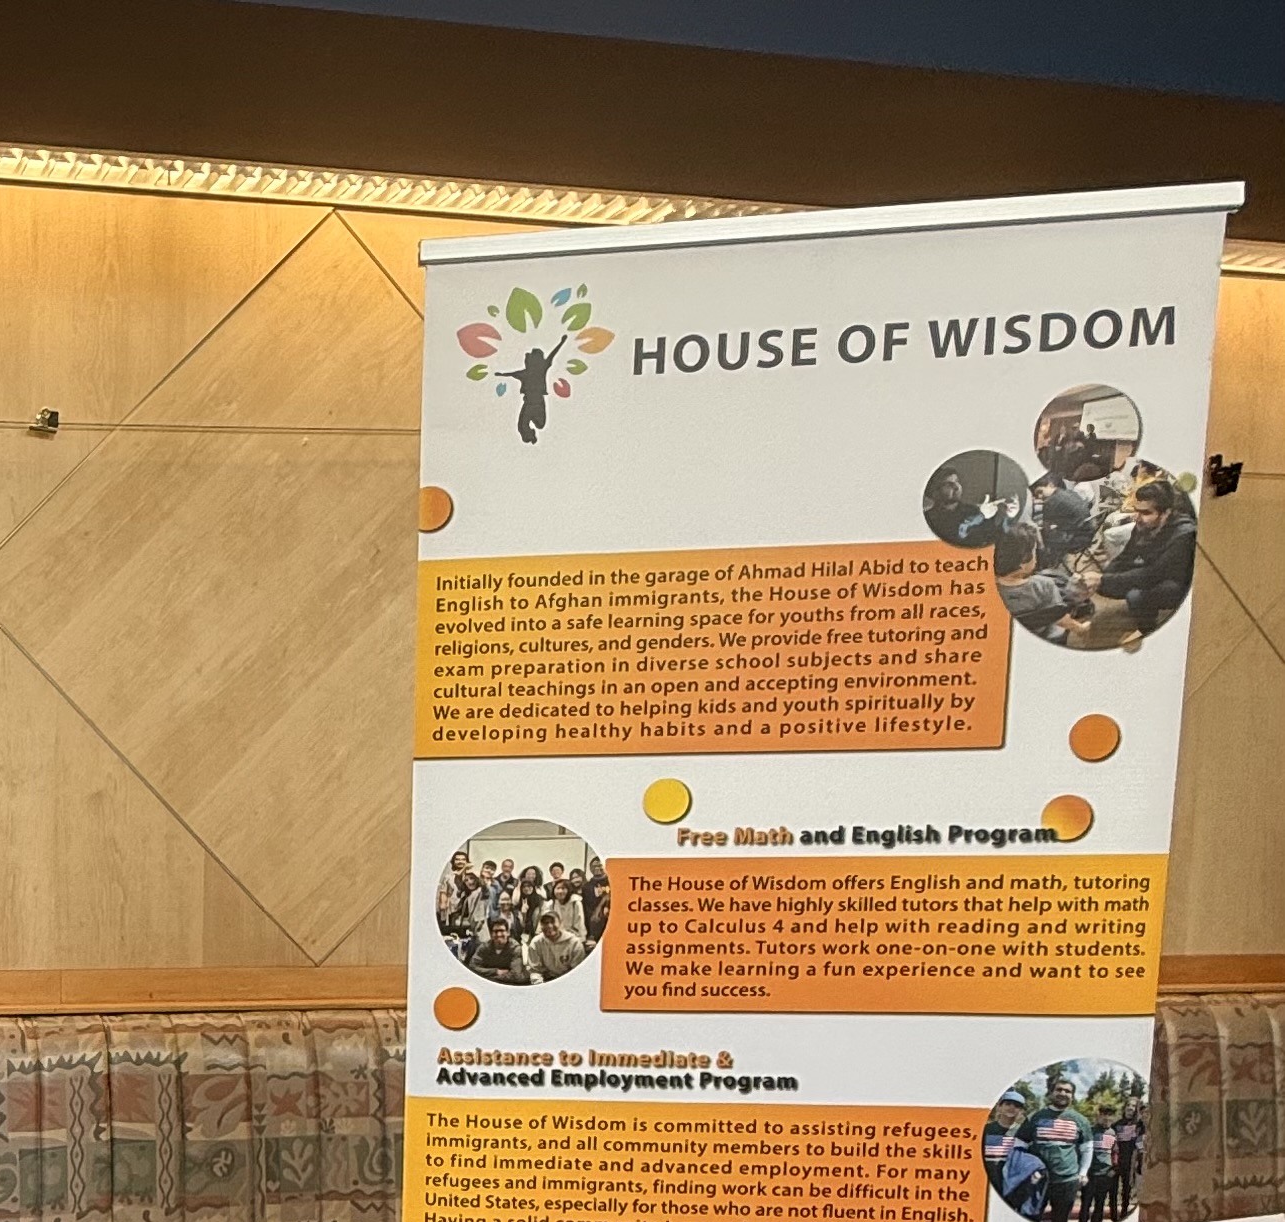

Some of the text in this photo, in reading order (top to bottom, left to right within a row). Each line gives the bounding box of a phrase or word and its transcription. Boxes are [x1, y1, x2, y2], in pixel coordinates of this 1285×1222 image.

[634, 306, 1174, 375] HOUSE OF WISDOM
[436, 556, 989, 592] Initially founded in the garage of Ahmad Hilal Abid to teach
[436, 580, 985, 615] English to Afghan immigrants, the House of Wisdom has
[677, 823, 1060, 848] Free Math and English Program
[628, 874, 1150, 894] The House of Wisdom offers English and math, tutoring
[626, 940, 1145, 958] assignments. Tutors work one-on-one with students.
[624, 982, 771, 1000] you find success.
[437, 1048, 734, 1069] Assistance to Immediate &
[436, 1067, 798, 1094] Advanced Employment Program
[427, 1113, 977, 1141] The House of Wisdom is committed to assisting refugees,
